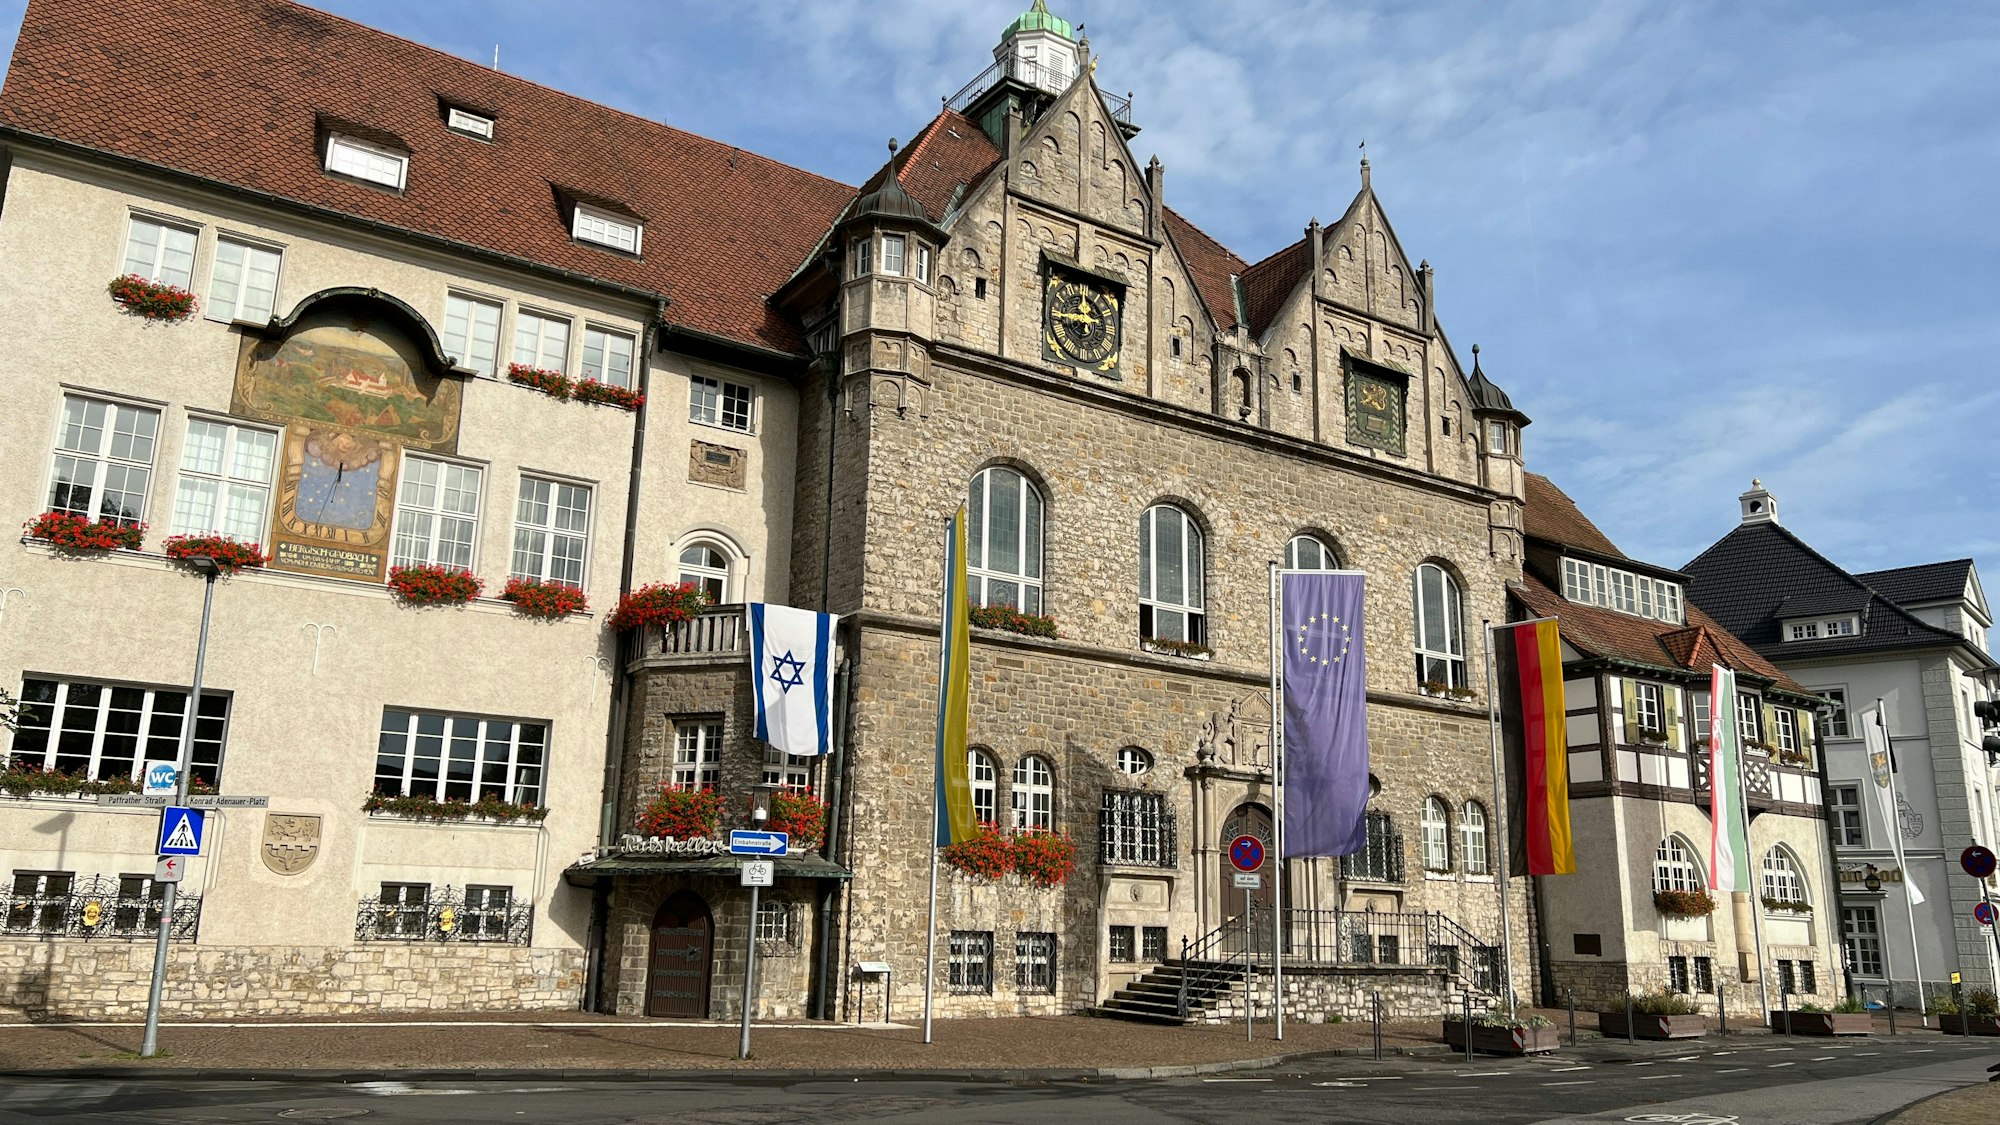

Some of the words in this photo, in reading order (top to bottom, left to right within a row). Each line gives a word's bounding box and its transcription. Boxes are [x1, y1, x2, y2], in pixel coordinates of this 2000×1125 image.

[151, 771, 174, 784] WC
[108, 795, 143, 805] Paffrather
[145, 796, 167, 805] Straße
[189, 797, 266, 807] Konrad-Adenauer-Platz
[621, 834, 726, 854] Ratskeller
[734, 839, 772, 847] Einbahnstraße
